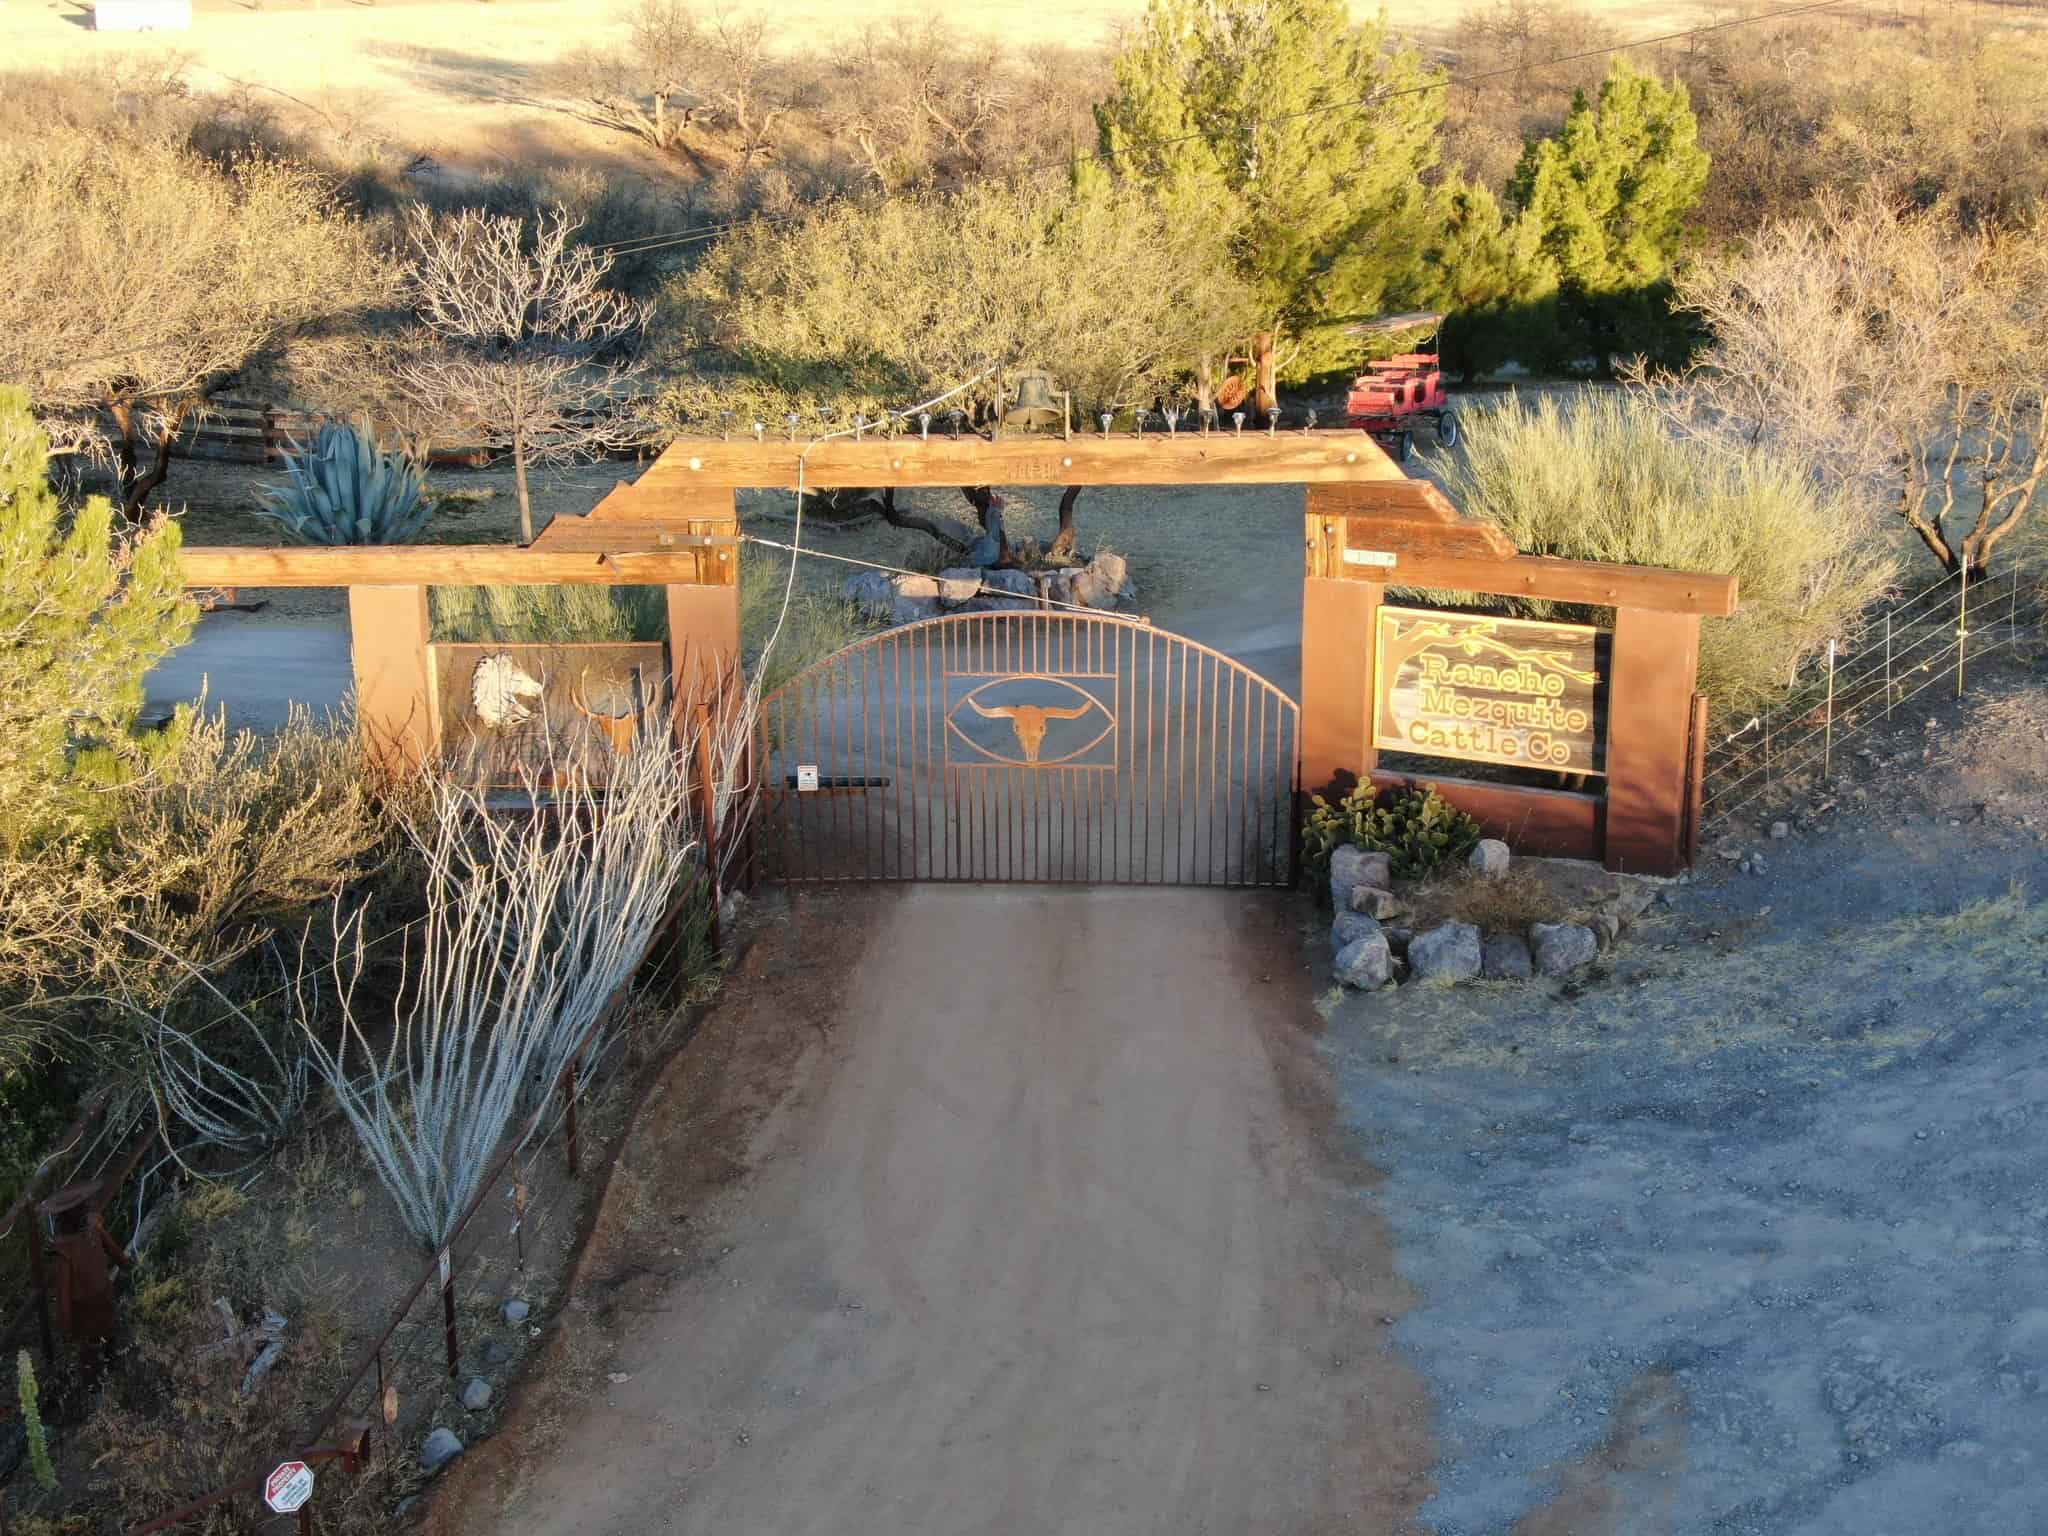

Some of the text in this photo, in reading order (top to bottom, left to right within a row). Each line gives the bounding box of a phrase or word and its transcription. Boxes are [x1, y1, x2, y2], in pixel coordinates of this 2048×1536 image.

[1420, 653, 1565, 695] Rancho
[1420, 688, 1586, 732] Mezquite
[1410, 721, 1569, 763] Cattle Co
